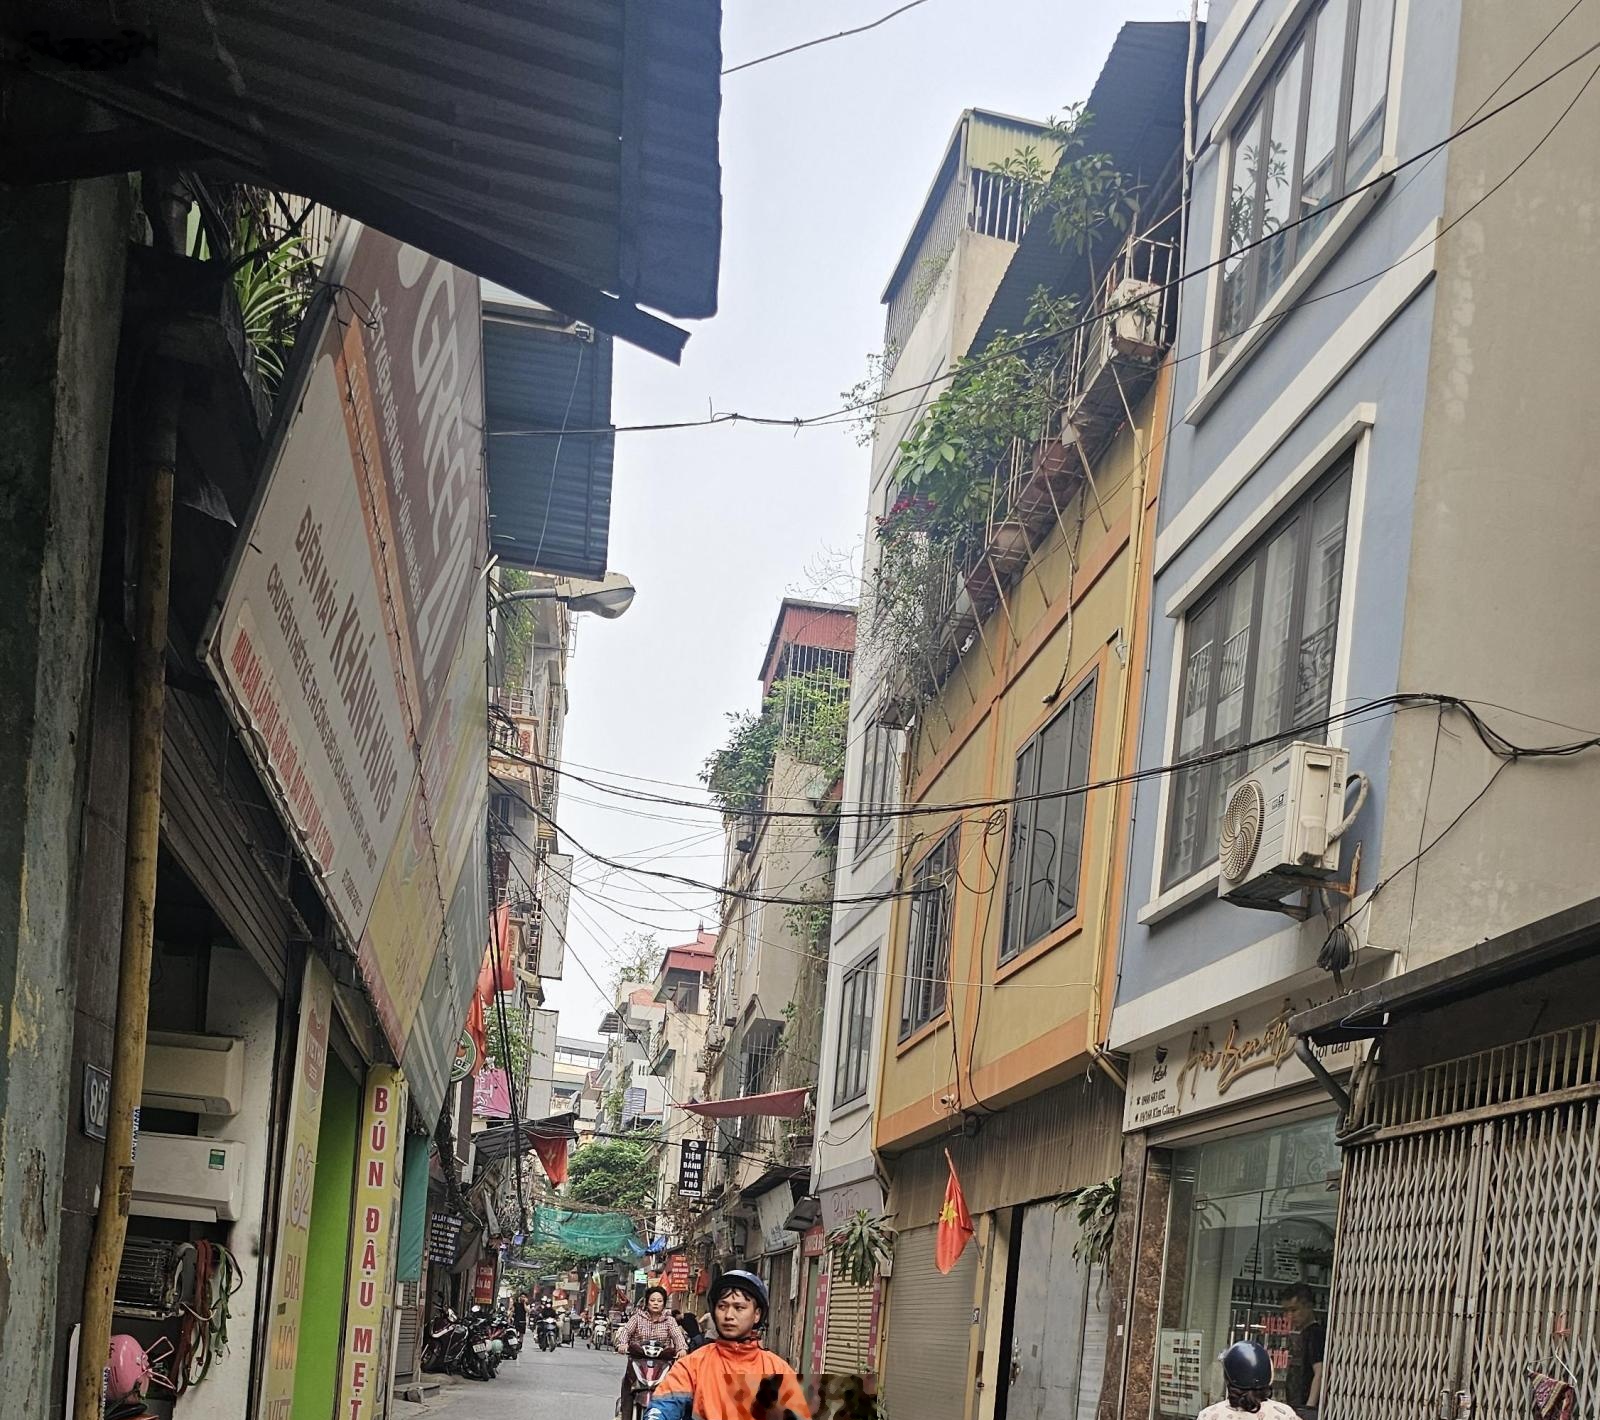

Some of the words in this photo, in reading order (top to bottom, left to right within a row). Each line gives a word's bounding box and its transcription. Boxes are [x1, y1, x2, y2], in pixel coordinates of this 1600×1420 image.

[412, 260, 468, 558] GREE
[416, 500, 471, 682] 20
[231, 627, 251, 680] MUA
[294, 504, 323, 591] ĐIỆN
[313, 566, 337, 641] MÁY
[329, 592, 378, 760] KHÁNH
[364, 711, 397, 824] HƯNG
[368, 1087, 388, 1187] BÚN
[290, 1143, 315, 1232] 82
[283, 1253, 301, 1301] BIA
[359, 1208, 380, 1306] ĐẬU
